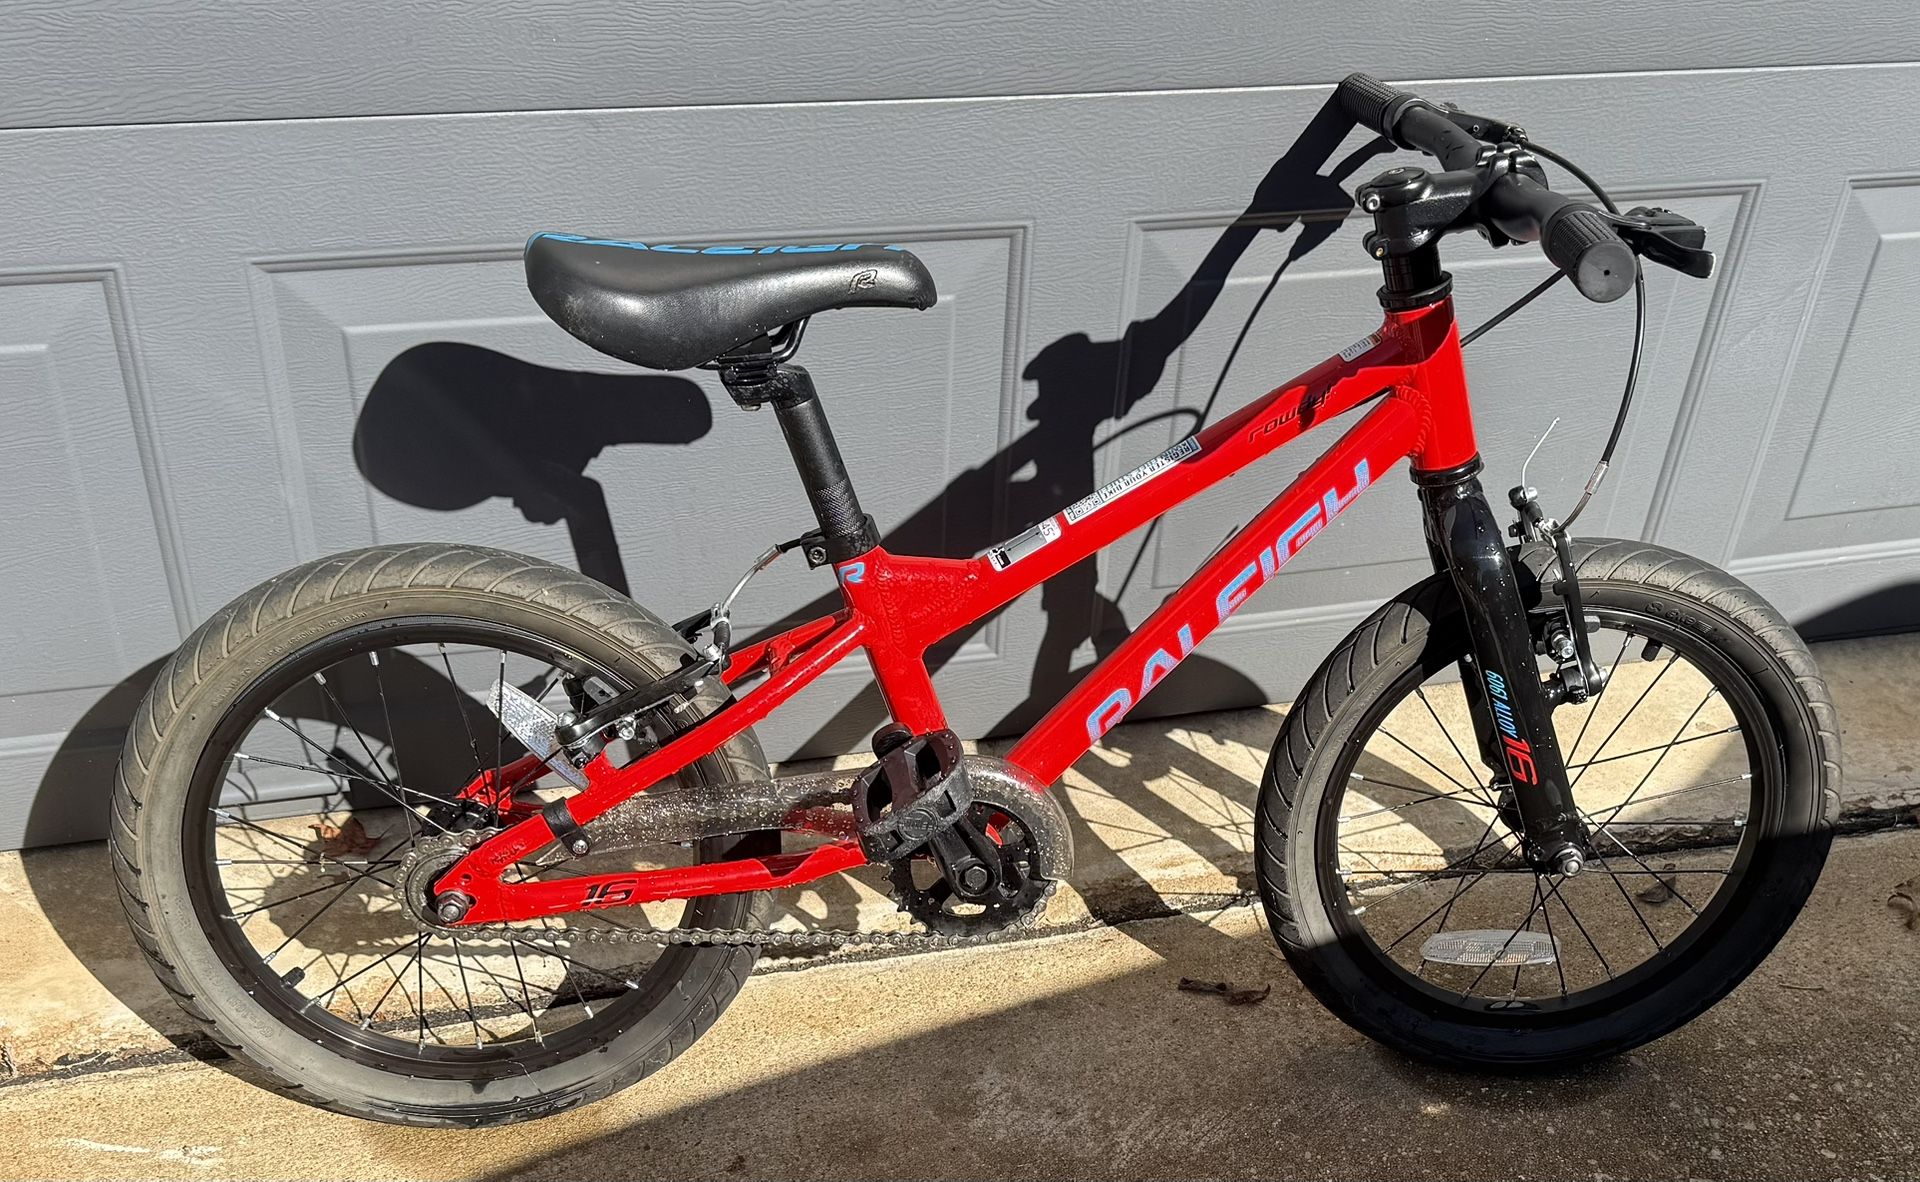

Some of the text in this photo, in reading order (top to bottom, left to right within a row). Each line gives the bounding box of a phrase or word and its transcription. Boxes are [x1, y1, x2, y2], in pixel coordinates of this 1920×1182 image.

[1148, 445, 1190, 472] REGISTER
[1123, 470, 1147, 487] YOUR
[1486, 669, 1517, 738] 6061 ALLOY
[1502, 735, 1538, 785] 16
